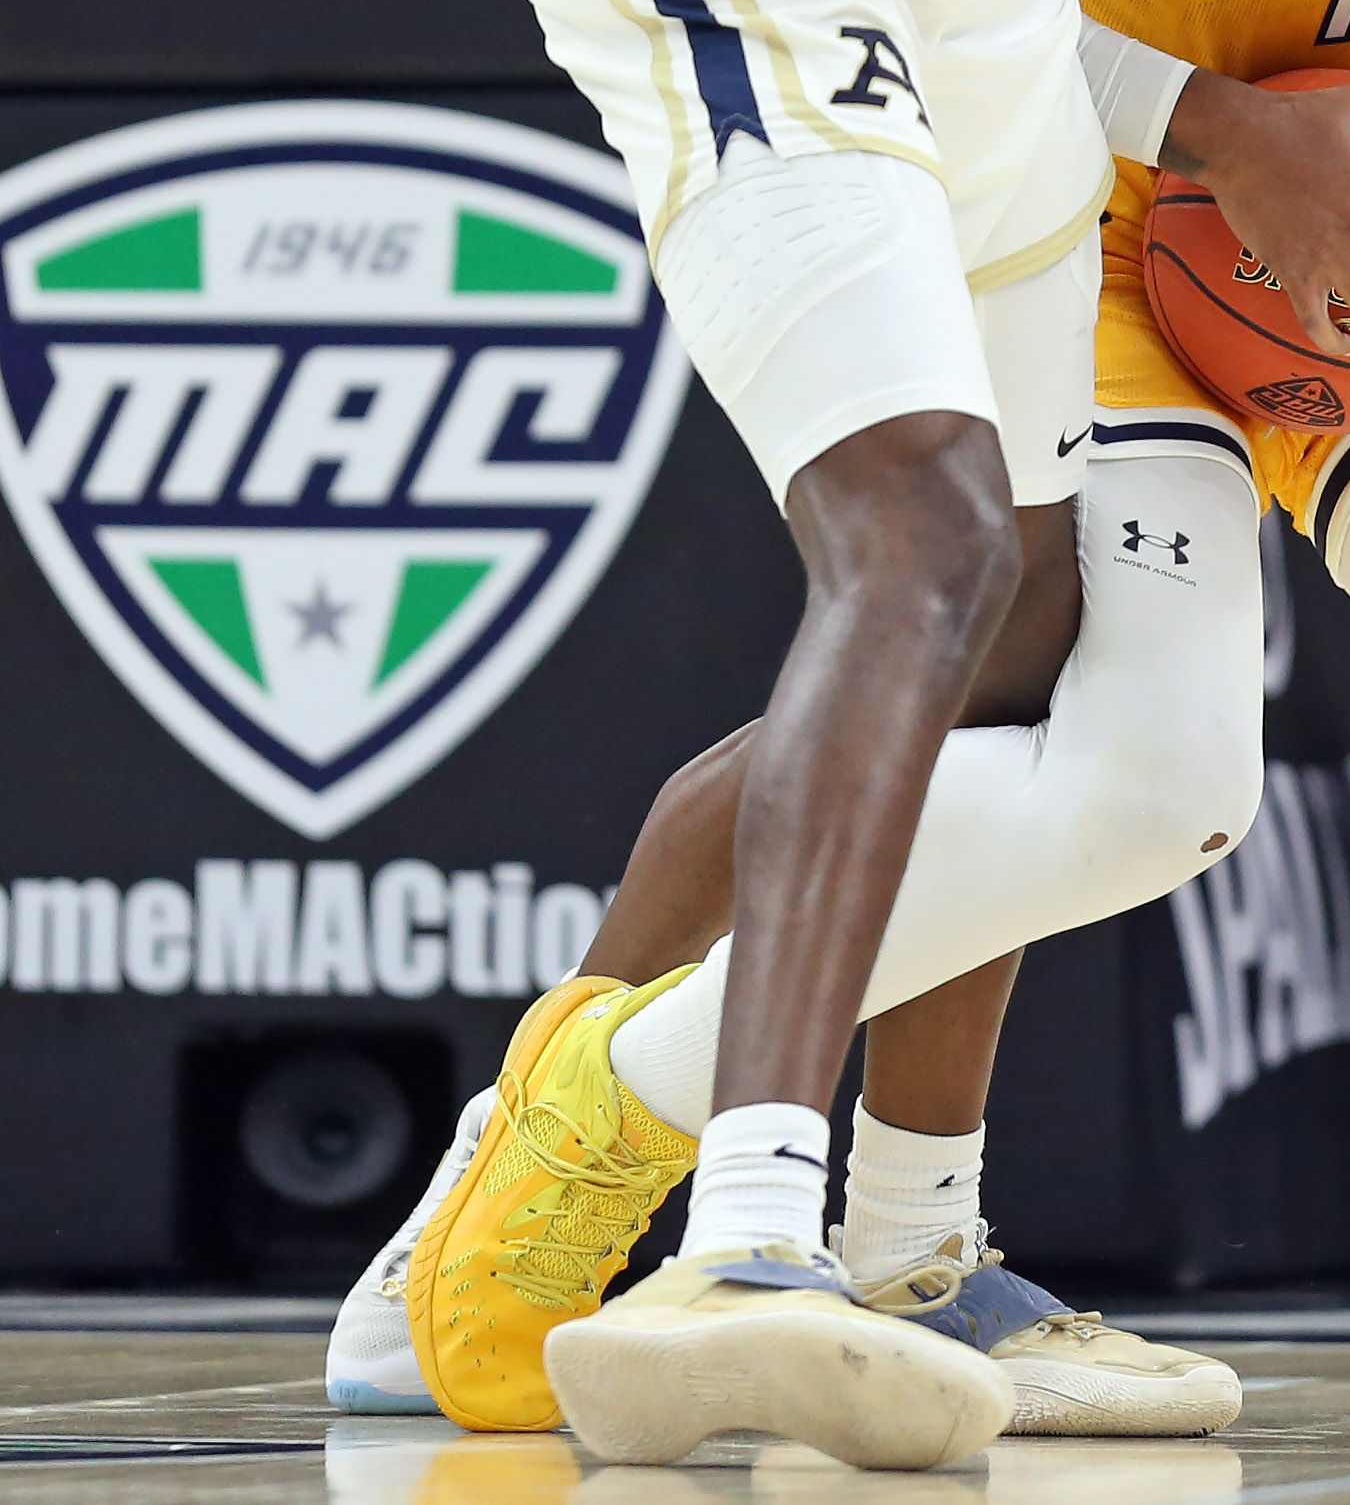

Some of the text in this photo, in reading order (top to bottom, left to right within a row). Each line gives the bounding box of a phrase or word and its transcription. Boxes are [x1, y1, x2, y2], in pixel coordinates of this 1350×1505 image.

[830, 25, 935, 134] A
[242, 218, 418, 276] 1946
[18, 342, 626, 506] MAC
[1113, 555, 1197, 587] UNDER ARMOUR
[0, 858, 622, 997] meMACtio
